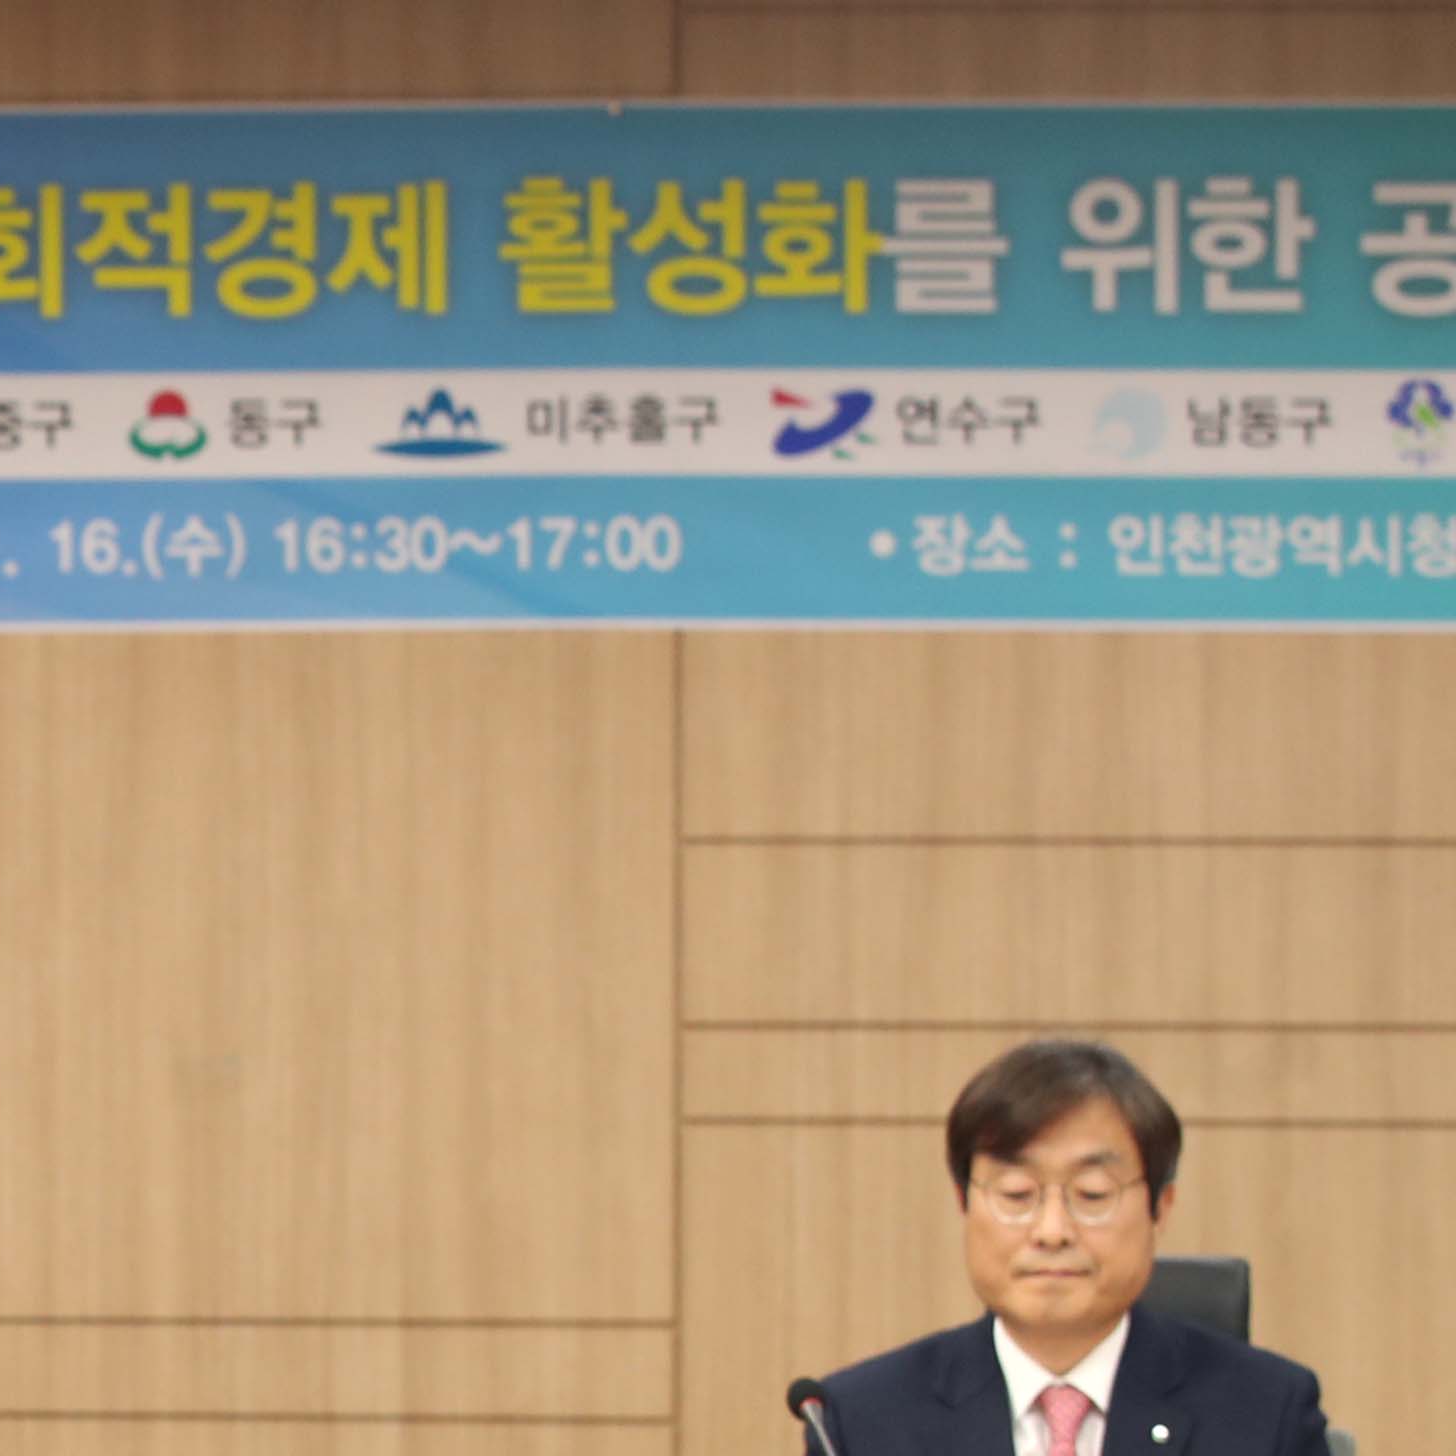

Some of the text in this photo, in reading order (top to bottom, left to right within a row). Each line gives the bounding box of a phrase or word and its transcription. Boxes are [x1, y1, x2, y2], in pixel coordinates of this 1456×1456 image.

[498, 177, 1010, 316] 활성화를
[1060, 178, 1317, 316] 위한
[227, 396, 323, 450] 동구
[525, 391, 721, 446] 미추홀구
[894, 395, 1041, 446] 연수구
[1186, 395, 1333, 449] 남동구
[50, 514, 246, 580] 16.(수)
[274, 513, 683, 574] 16:30~17:00
[912, 512, 1030, 577] 장소
